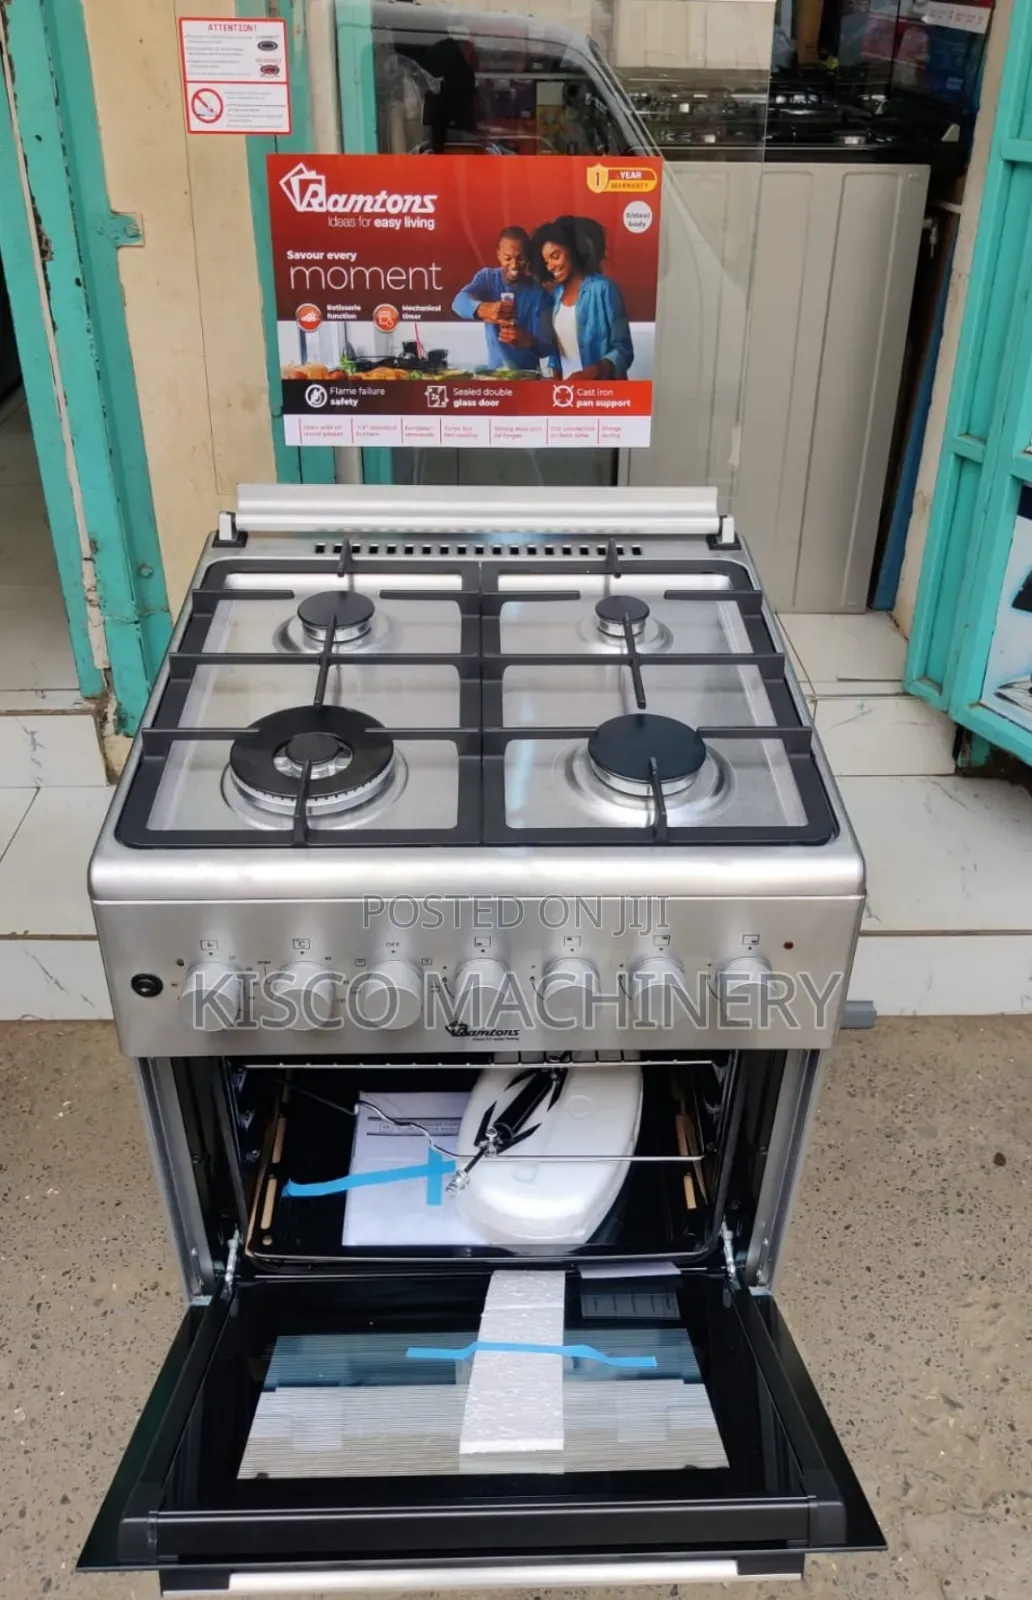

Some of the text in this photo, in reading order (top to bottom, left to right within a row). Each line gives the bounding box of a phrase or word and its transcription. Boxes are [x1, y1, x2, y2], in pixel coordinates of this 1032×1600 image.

[208, 23, 257, 32] ATTENTION!
[620, 171, 642, 179] YEAR
[296, 180, 438, 214] Ramtons
[328, 216, 435, 230] Ideas for easy living
[287, 250, 357, 262] Savour every
[290, 262, 443, 290] moment
[330, 386, 386, 395] Flame failure
[453, 388, 513, 397] Sealed double
[577, 388, 614, 396] Cast iron
[330, 397, 359, 407] safety
[453, 398, 500, 408] glass door
[577, 399, 631, 409] pan support
